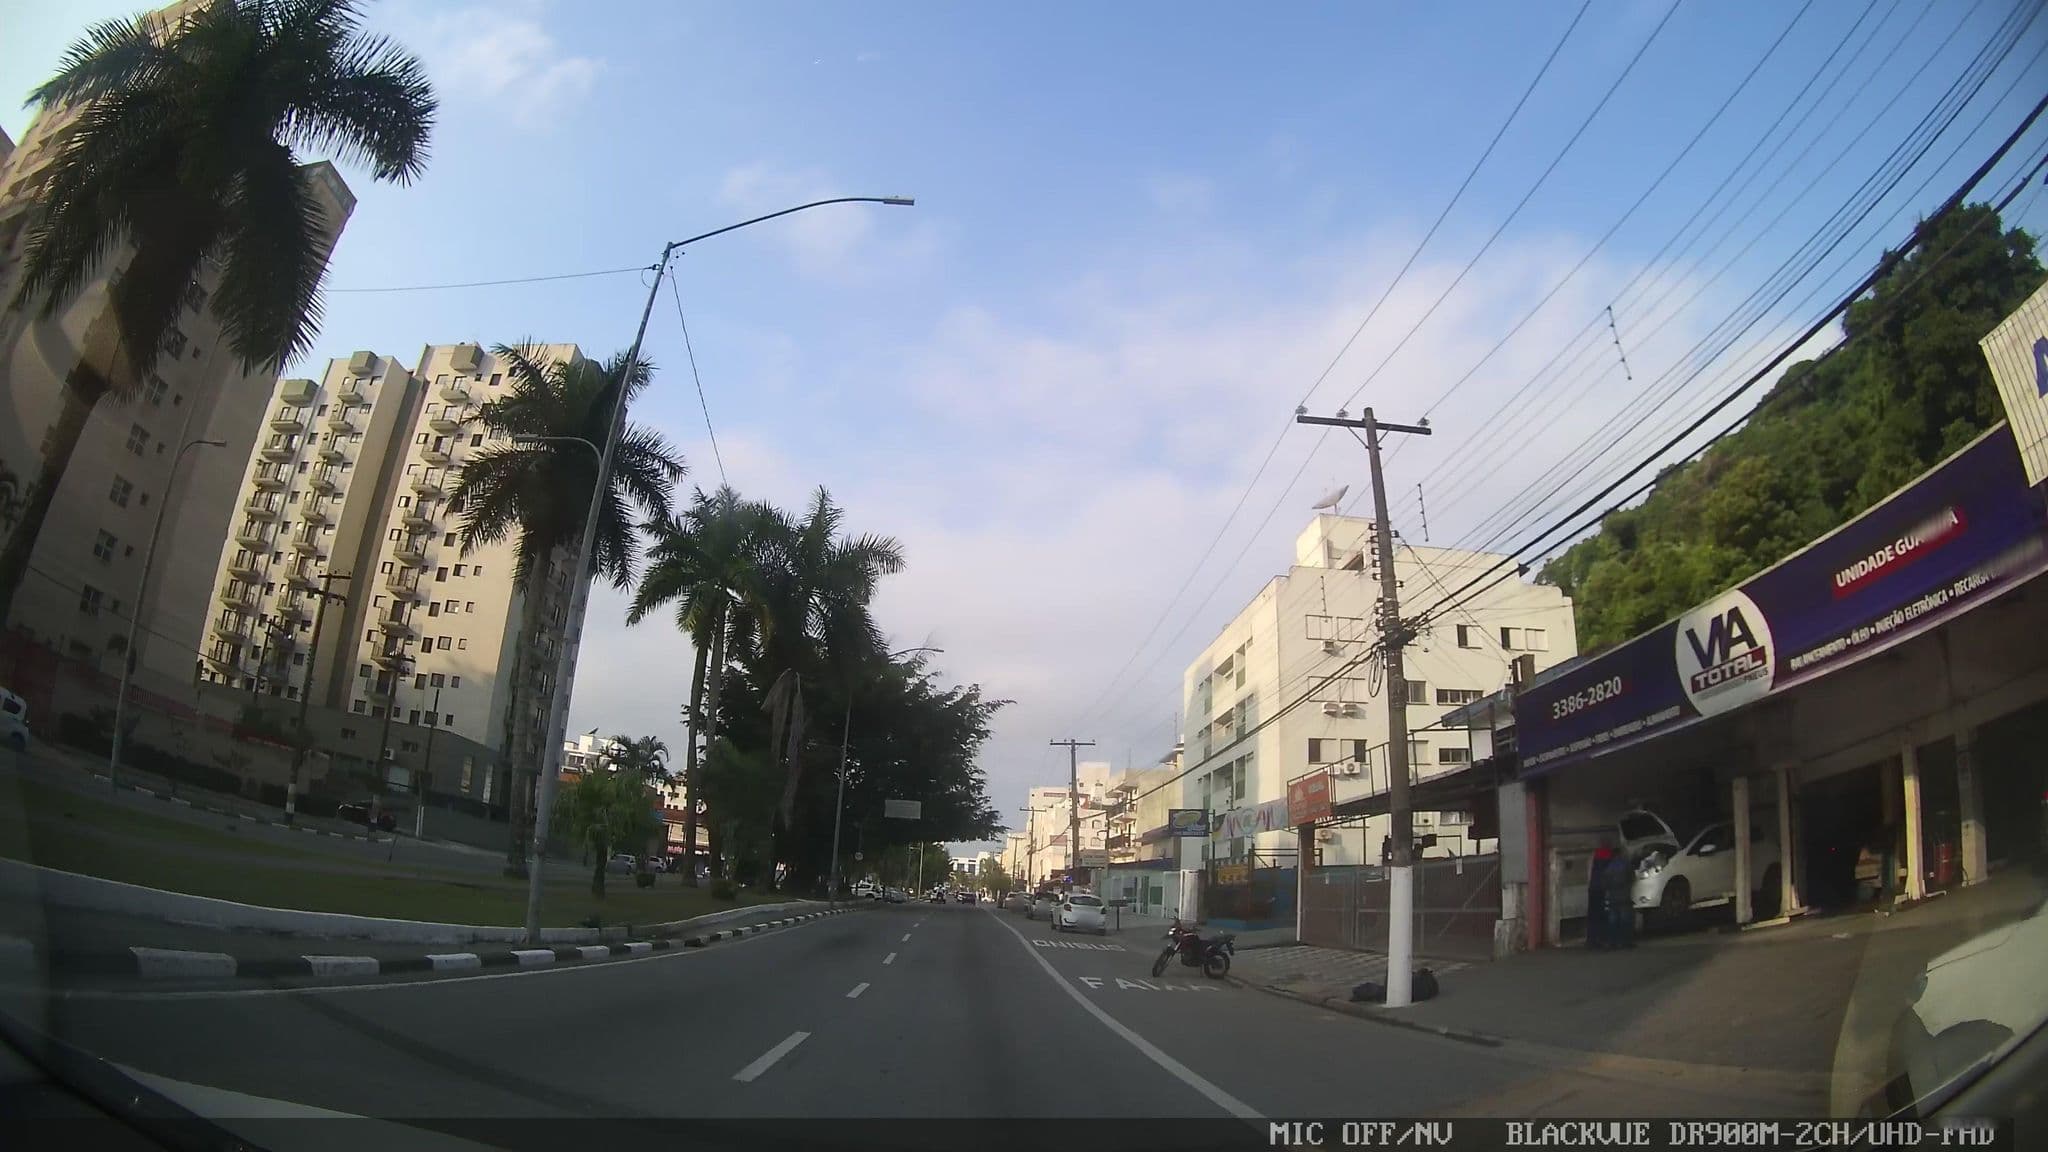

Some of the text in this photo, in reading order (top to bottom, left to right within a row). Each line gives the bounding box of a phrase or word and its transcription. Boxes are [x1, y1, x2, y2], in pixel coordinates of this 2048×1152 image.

[1836, 545, 1895, 587] UNIDADE
[1694, 654, 1762, 688] TOTAL
[1552, 676, 1622, 719] 3386-2820
